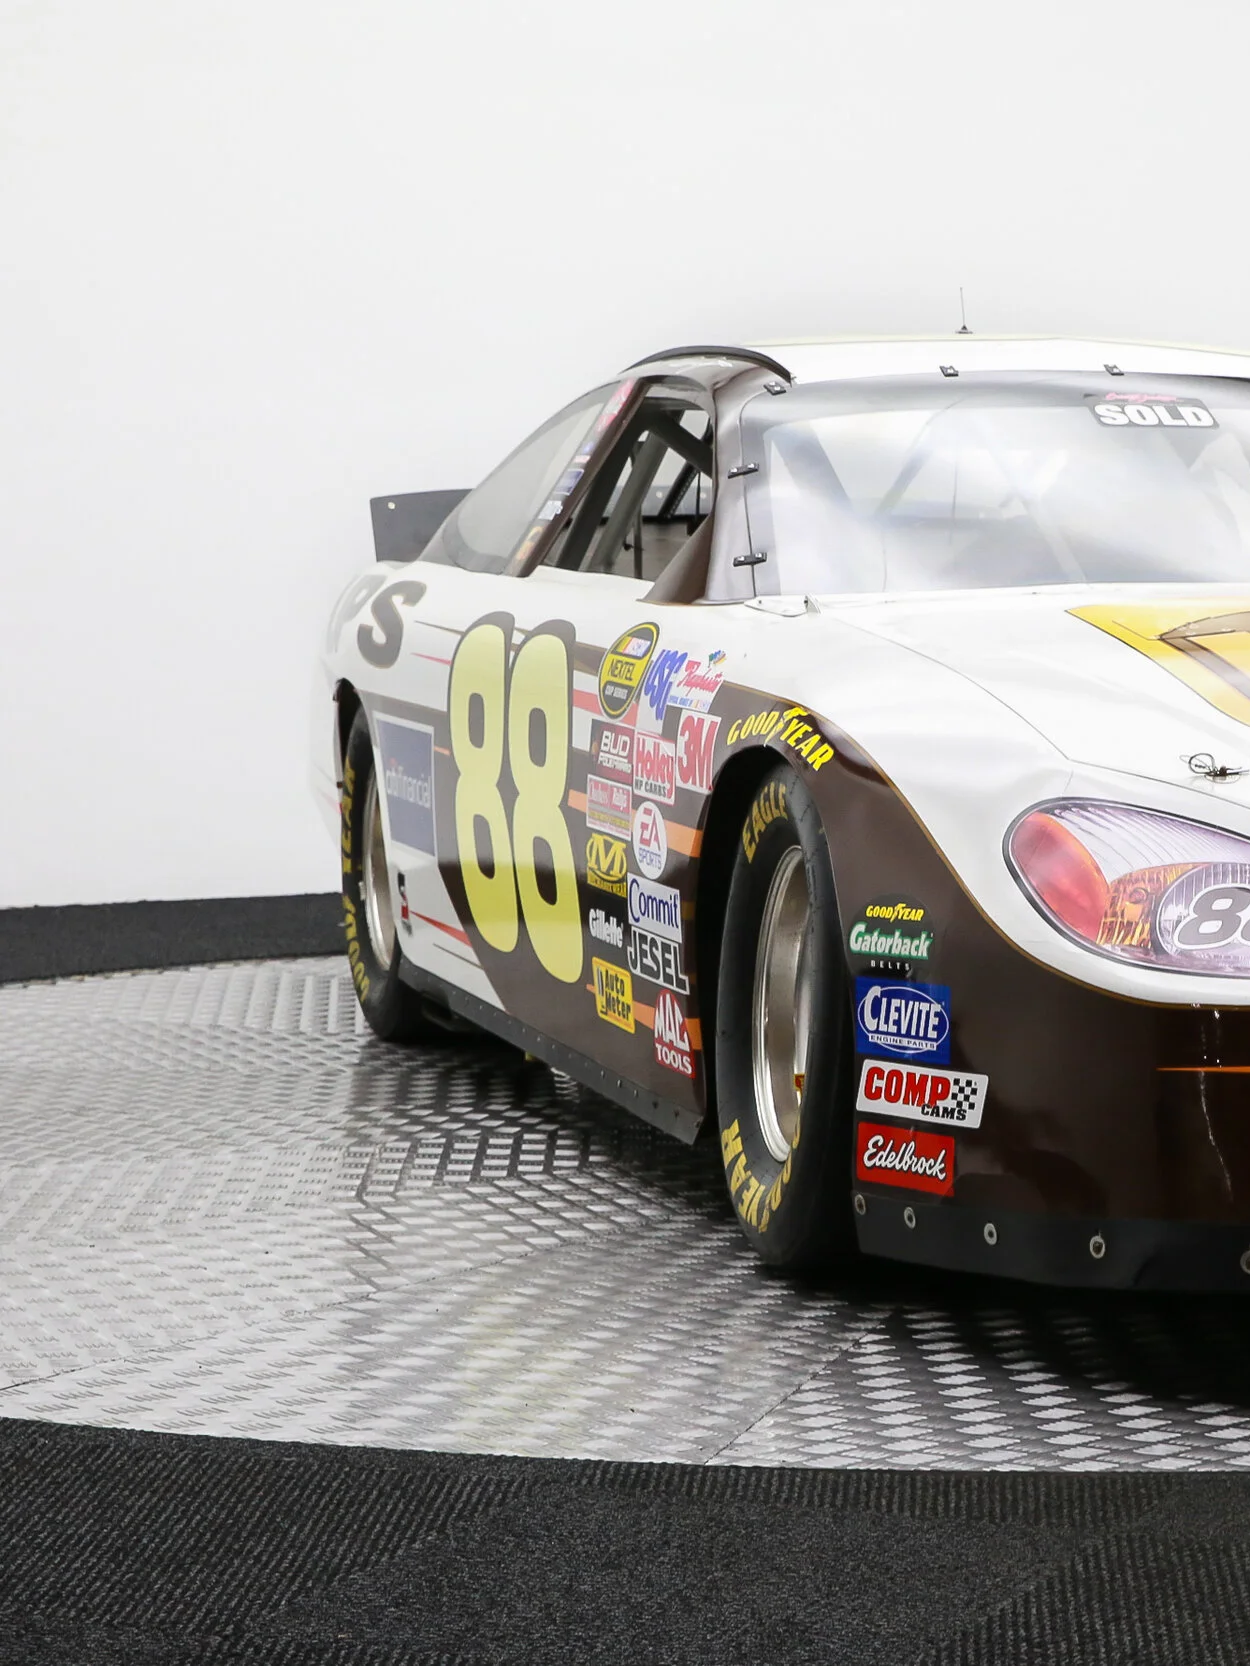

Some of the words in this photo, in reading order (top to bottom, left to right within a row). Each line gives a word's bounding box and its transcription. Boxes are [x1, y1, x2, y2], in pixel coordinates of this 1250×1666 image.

[1094, 404, 1214, 426] SOLD
[607, 658, 637, 682] NEXTEL
[600, 730, 631, 757] BUD
[677, 715, 719, 791] 3M
[636, 736, 674, 799] Holley
[448, 611, 584, 984] 88
[644, 779, 667, 798] CARBS
[640, 807, 661, 851] EA
[742, 781, 788, 864] EAGLE
[638, 847, 661, 870] SPORTS
[629, 878, 679, 928] Commit
[589, 908, 623, 948] Gillette
[850, 922, 931, 958] Gatorback
[627, 925, 690, 995] JESEL
[870, 959, 910, 971] BELTS
[605, 969, 625, 996] Auto
[605, 993, 631, 1021] Meter
[654, 993, 690, 1052] MAC
[863, 986, 942, 1039] CLEVITE
[655, 1042, 692, 1075] TOOLS
[870, 1034, 904, 1046] ENGINE
[906, 1039, 936, 1050] PARTS
[863, 1066, 951, 1107] COMP
[921, 1103, 967, 1121] CAMS
[863, 1135, 947, 1180] Edelbrock
